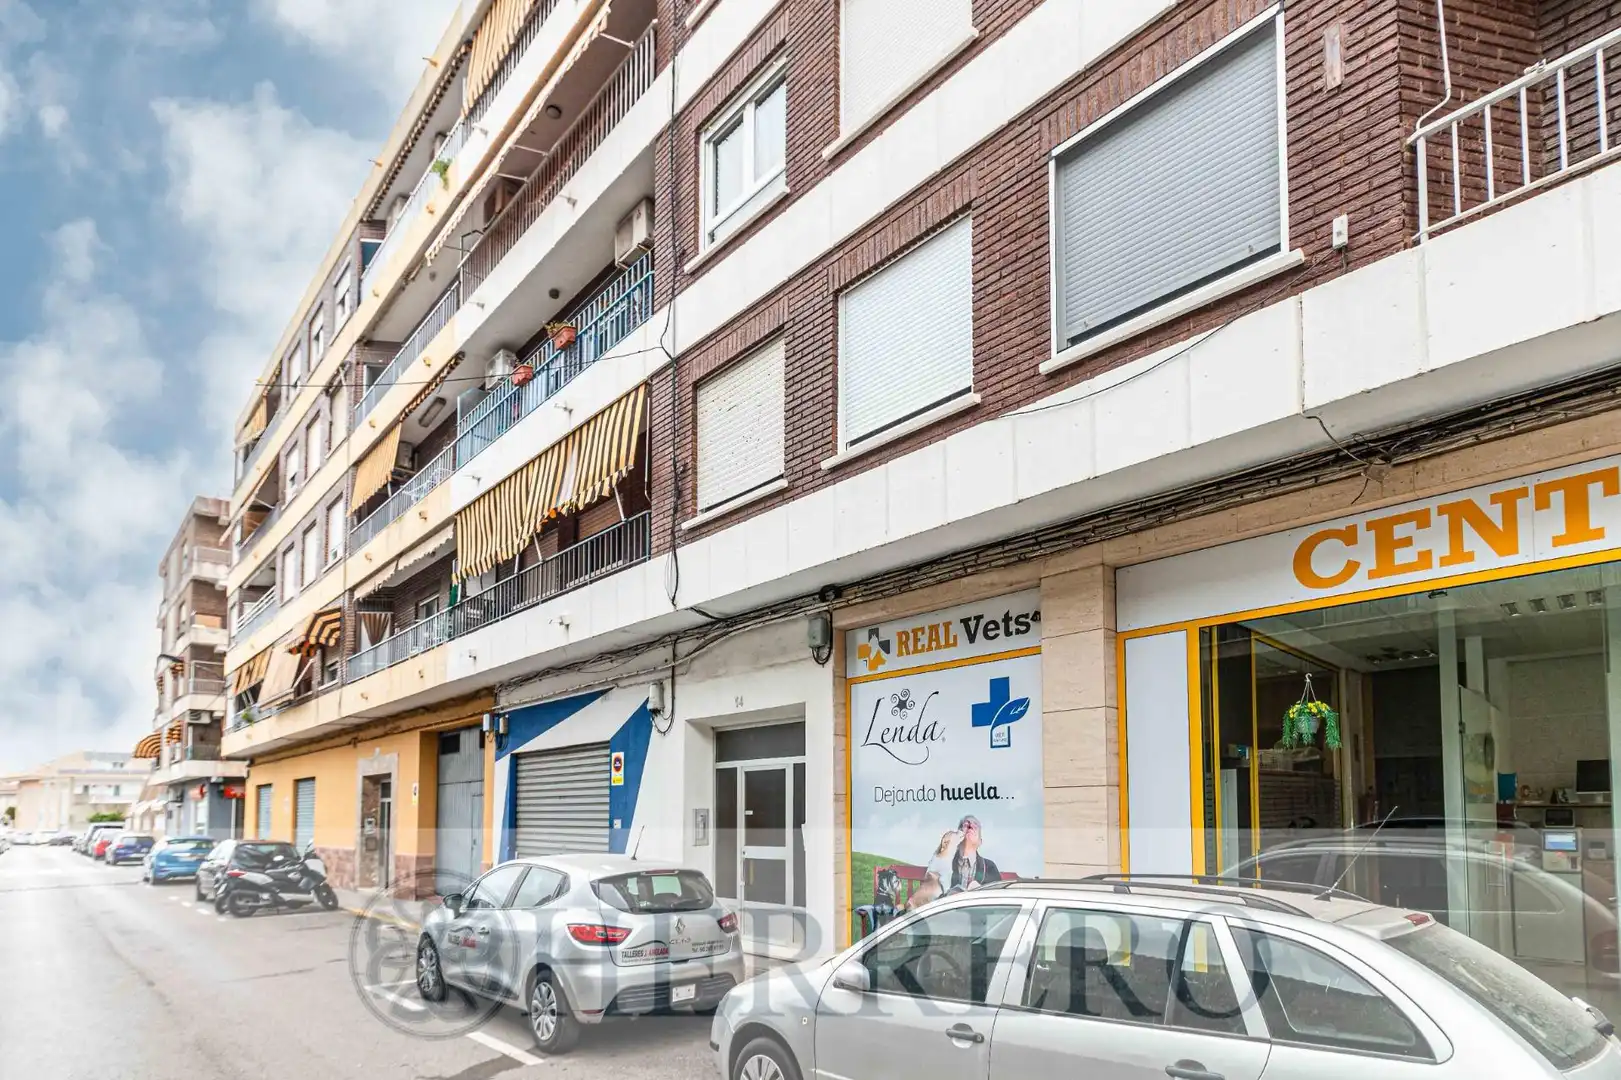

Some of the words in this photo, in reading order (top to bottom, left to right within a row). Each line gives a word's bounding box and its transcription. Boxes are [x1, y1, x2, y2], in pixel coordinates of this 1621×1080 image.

[1293, 466, 1620, 589] CENT
[896, 621, 958, 657] REAL
[960, 610, 1032, 644] Vets
[861, 690, 945, 765] Lenda
[874, 784, 936, 806] Dejando
[621, 948, 644, 959] TALLERES
